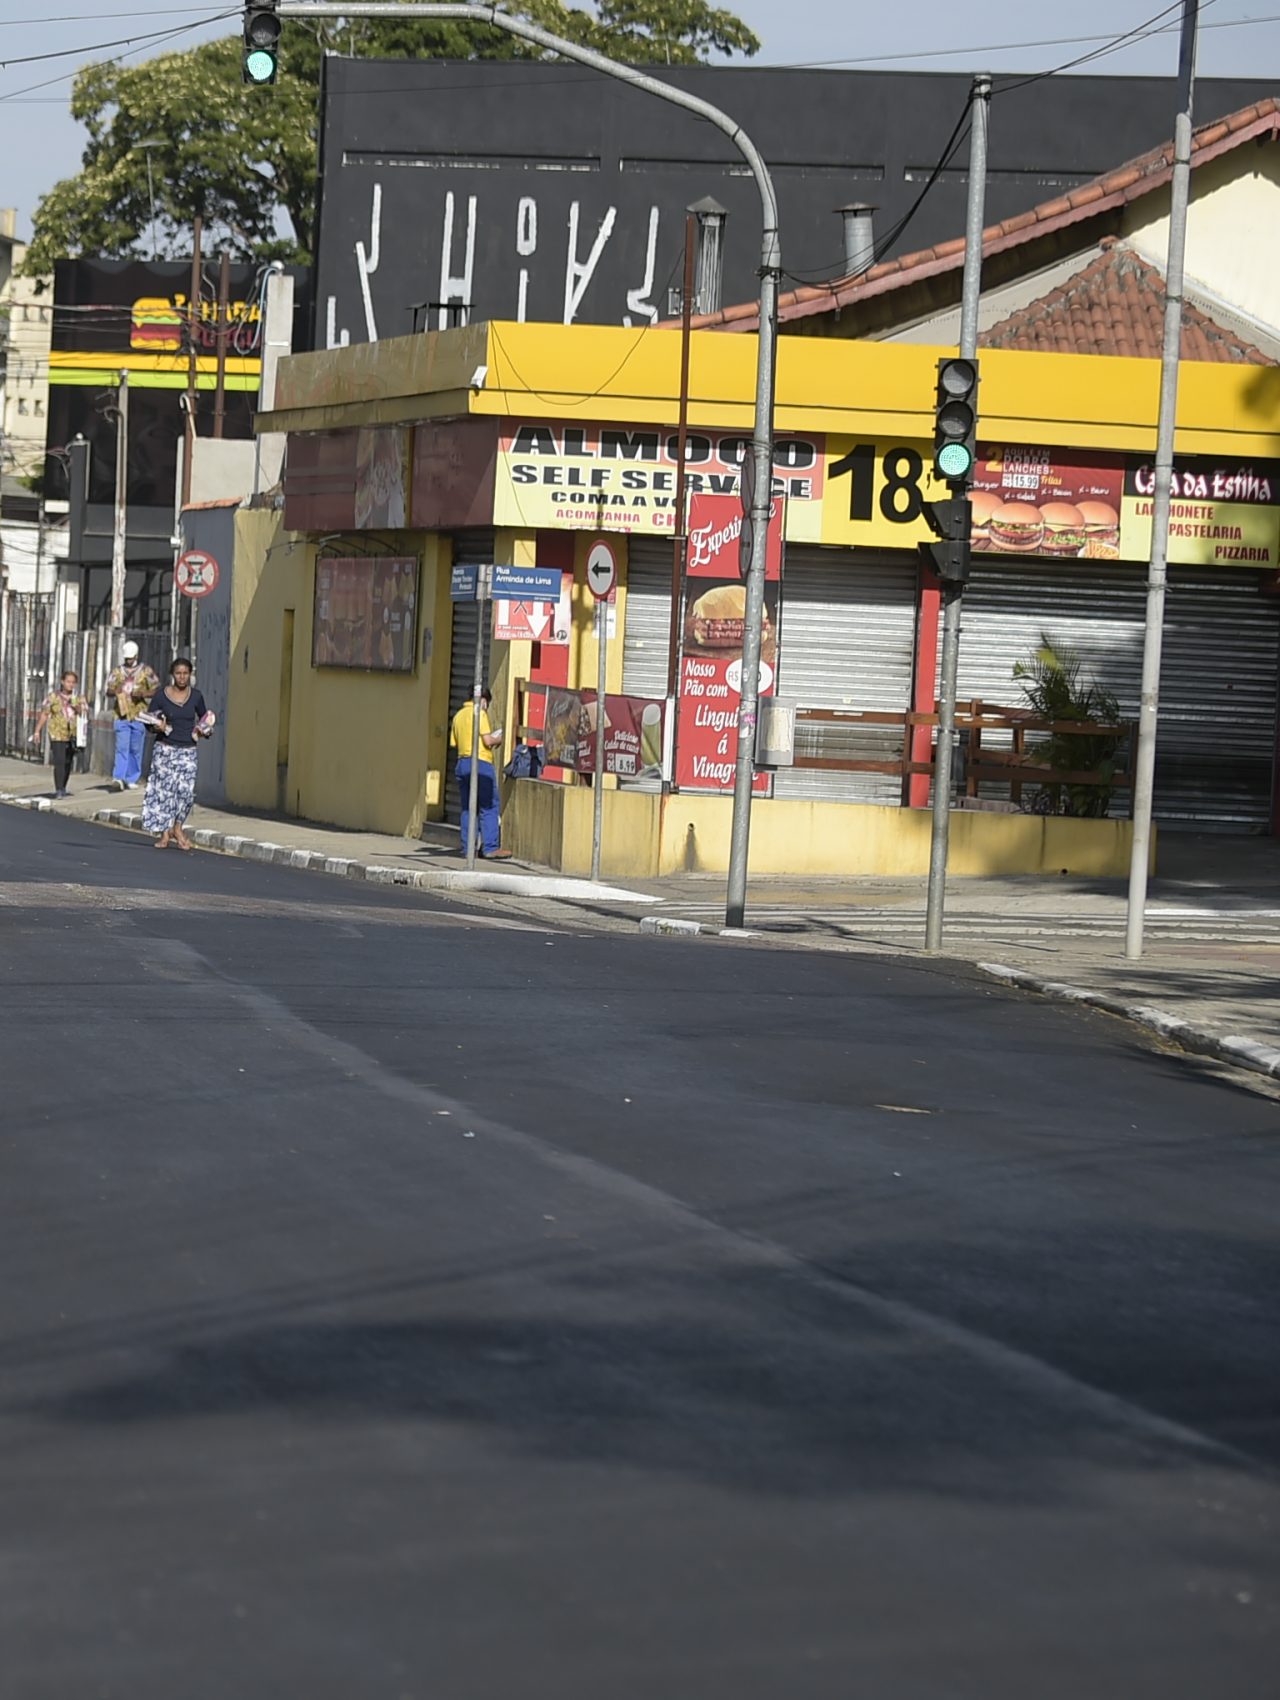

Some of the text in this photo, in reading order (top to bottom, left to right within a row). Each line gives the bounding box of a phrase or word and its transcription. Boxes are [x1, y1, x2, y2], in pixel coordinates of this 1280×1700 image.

[512, 426, 816, 471] ALMOÇO
[511, 463, 812, 499] SELF SERVCE
[556, 509, 641, 523] ACOMPANHA
[1169, 523, 1242, 540] PASTELARIA
[1215, 545, 1269, 561] PIZZARIA
[496, 566, 510, 575] Rua
[496, 574, 523, 584] Arminda
[536, 576, 551, 585] Lima
[686, 660, 715, 676] Nosso
[685, 681, 728, 697] Pão com
[695, 704, 740, 732] Lingui
